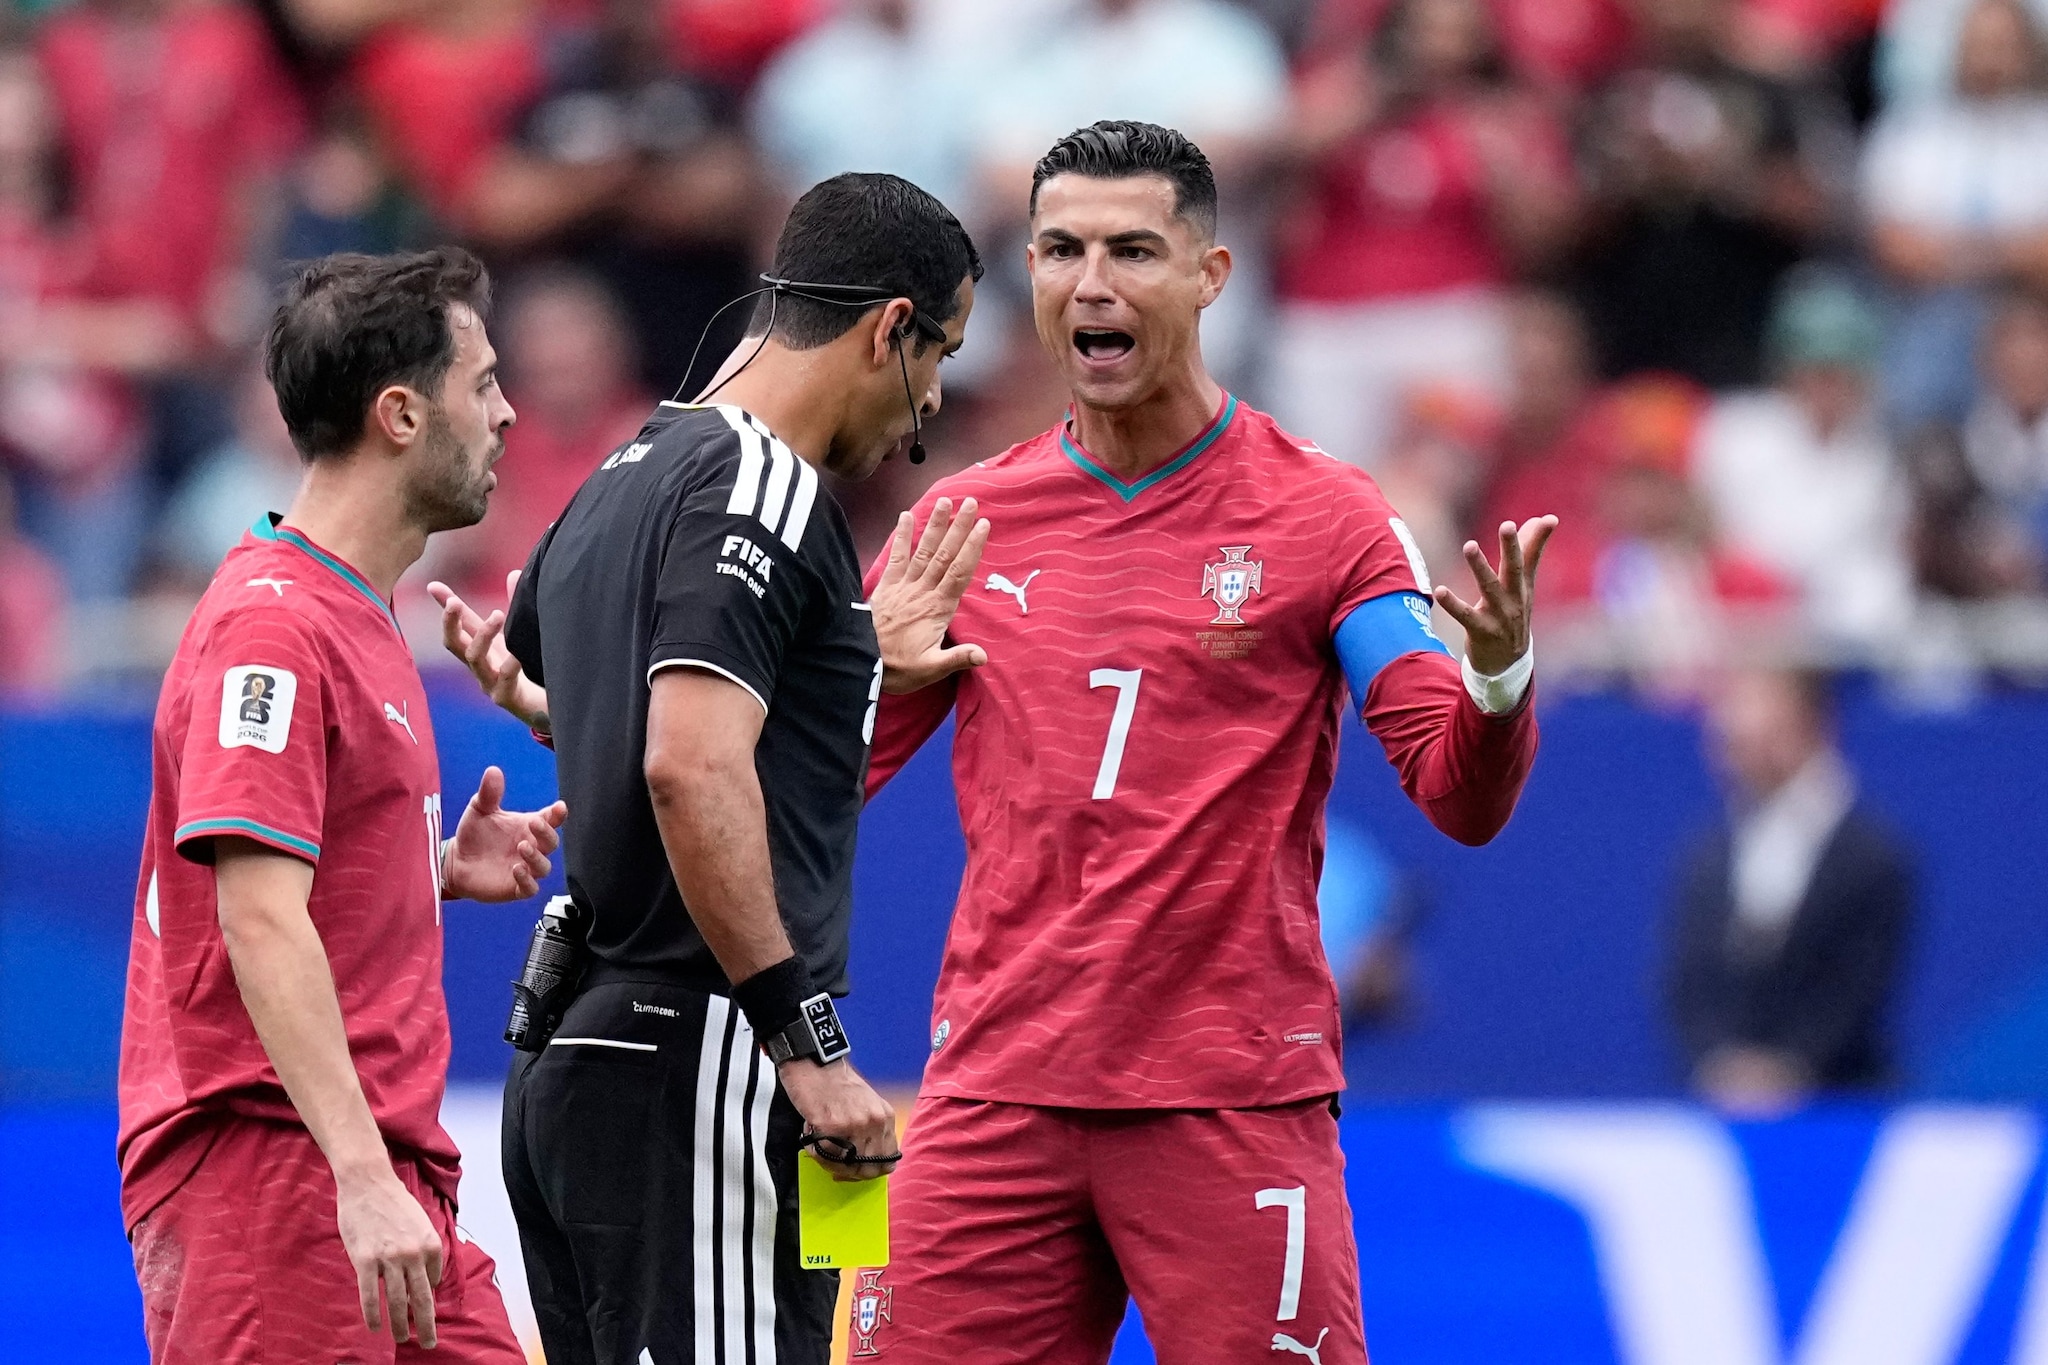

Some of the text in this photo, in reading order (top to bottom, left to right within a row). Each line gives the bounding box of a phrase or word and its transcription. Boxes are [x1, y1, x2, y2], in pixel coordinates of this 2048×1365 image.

[720, 535, 772, 583] FIFA
[716, 562, 766, 599] TEAM ONE
[245, 711, 262, 721] FIFA
[1089, 668, 1143, 800] 7
[237, 730, 267, 742] 2026
[806, 1255, 831, 1264] FIFA
[1255, 1185, 1306, 1321] 7
